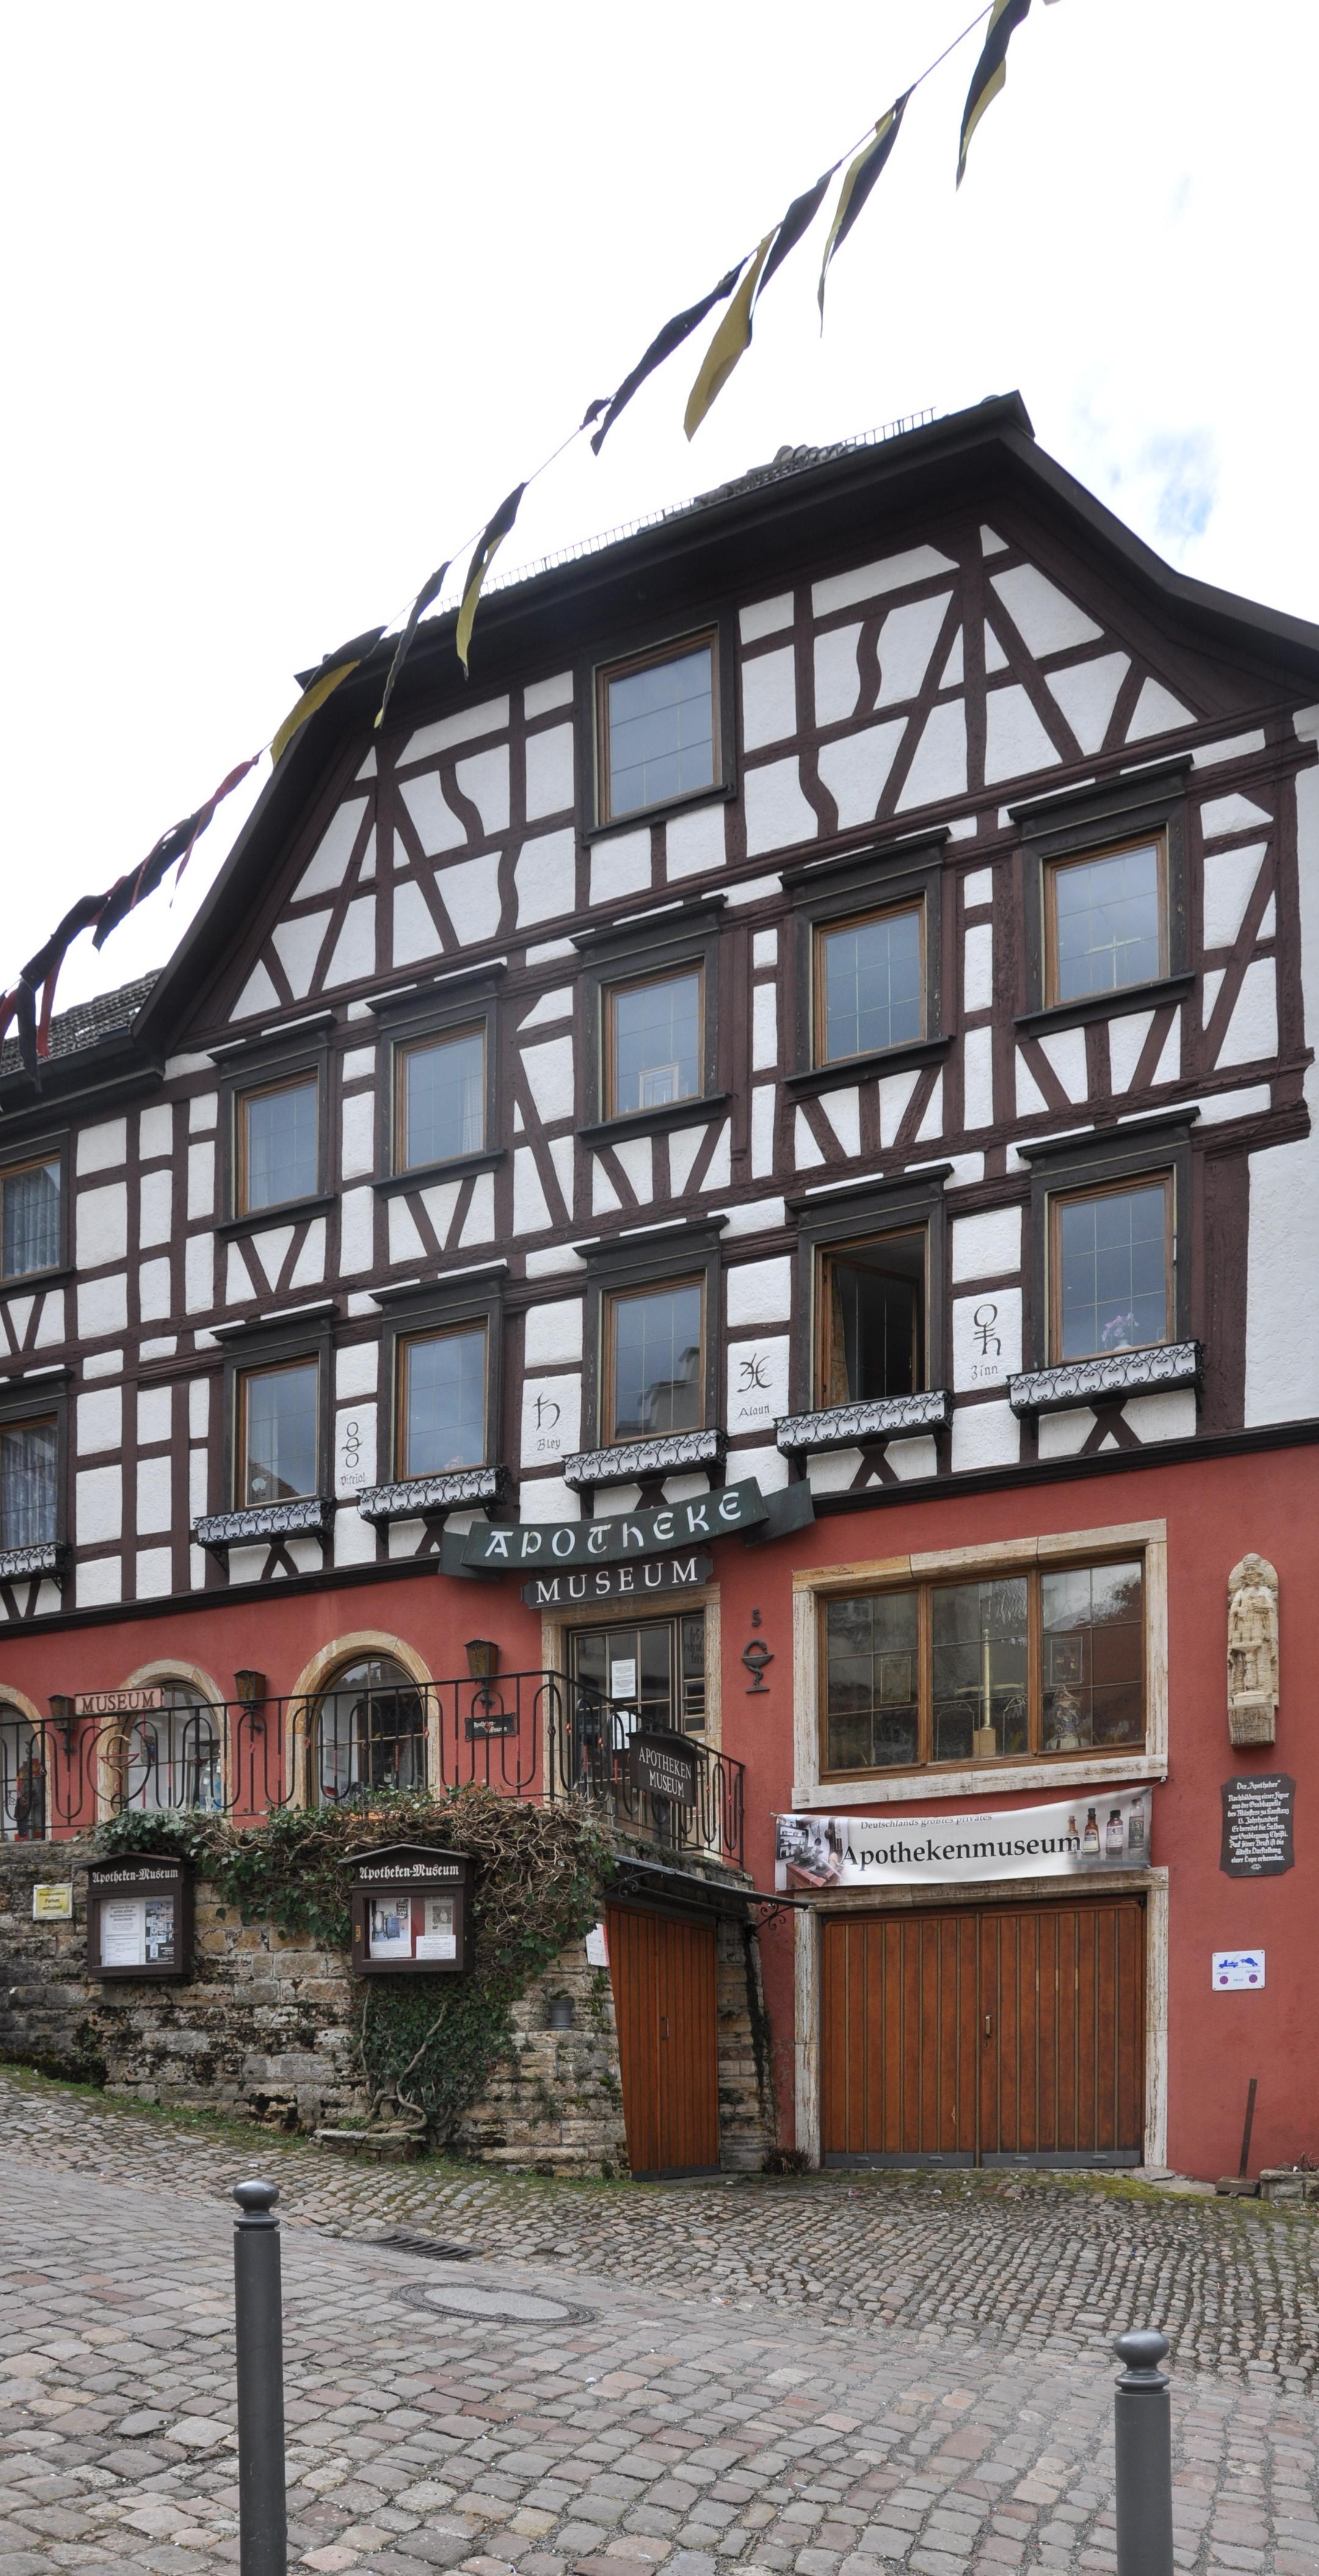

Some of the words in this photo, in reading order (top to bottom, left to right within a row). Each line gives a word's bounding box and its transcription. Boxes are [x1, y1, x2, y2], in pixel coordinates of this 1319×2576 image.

[737, 1405, 769, 1419] Alaun
[537, 1439, 561, 1451] Bley
[536, 1557, 698, 1603] MUSEUM
[752, 1609, 761, 1626] 5
[82, 1691, 154, 1714] MUSEUM
[639, 1746, 691, 1780] APOTHEKEN
[649, 1769, 685, 1798] MUSEUM
[1273, 1791, 1290, 1800] Figur
[861, 1819, 918, 1830] Deutschlands
[1245, 1816, 1279, 1824] Jahrhundert
[1229, 1839, 1241, 1848] Auf
[841, 1835, 1081, 1872] Apothekenmuseum
[92, 1868, 179, 1884] Apotheken-Museum
[359, 1864, 459, 1880] Apotheken-Museum
